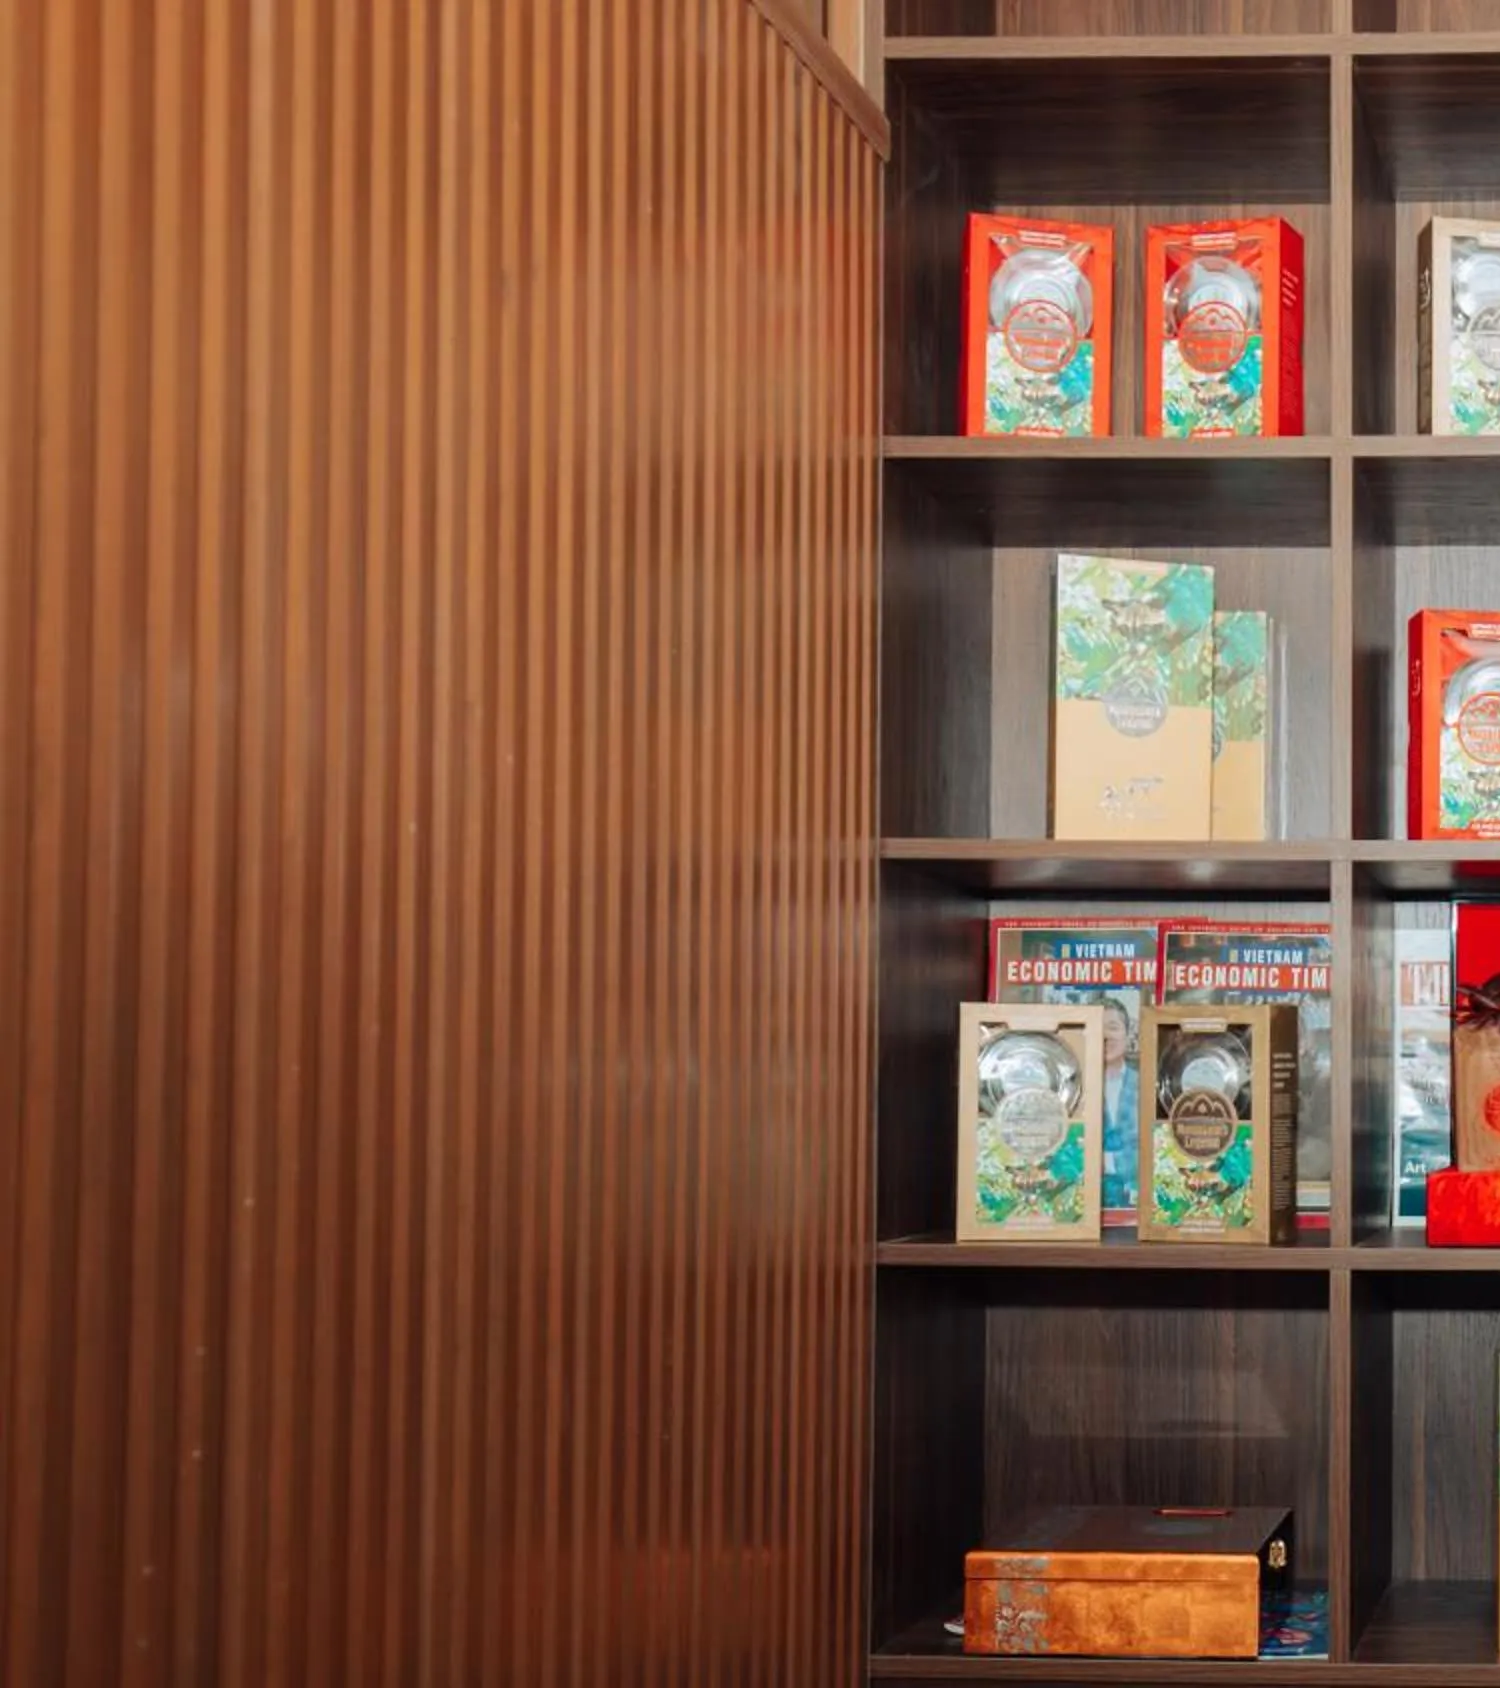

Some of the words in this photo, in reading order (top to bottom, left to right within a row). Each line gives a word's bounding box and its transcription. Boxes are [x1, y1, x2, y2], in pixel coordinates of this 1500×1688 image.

[1075, 943, 1135, 958] VIETNAM
[1243, 949, 1303, 965] VIETNAM
[1007, 960, 1112, 982] ECONOMIC
[1175, 965, 1280, 988] ECONOMIC
[1404, 1160, 1427, 1173] Art
